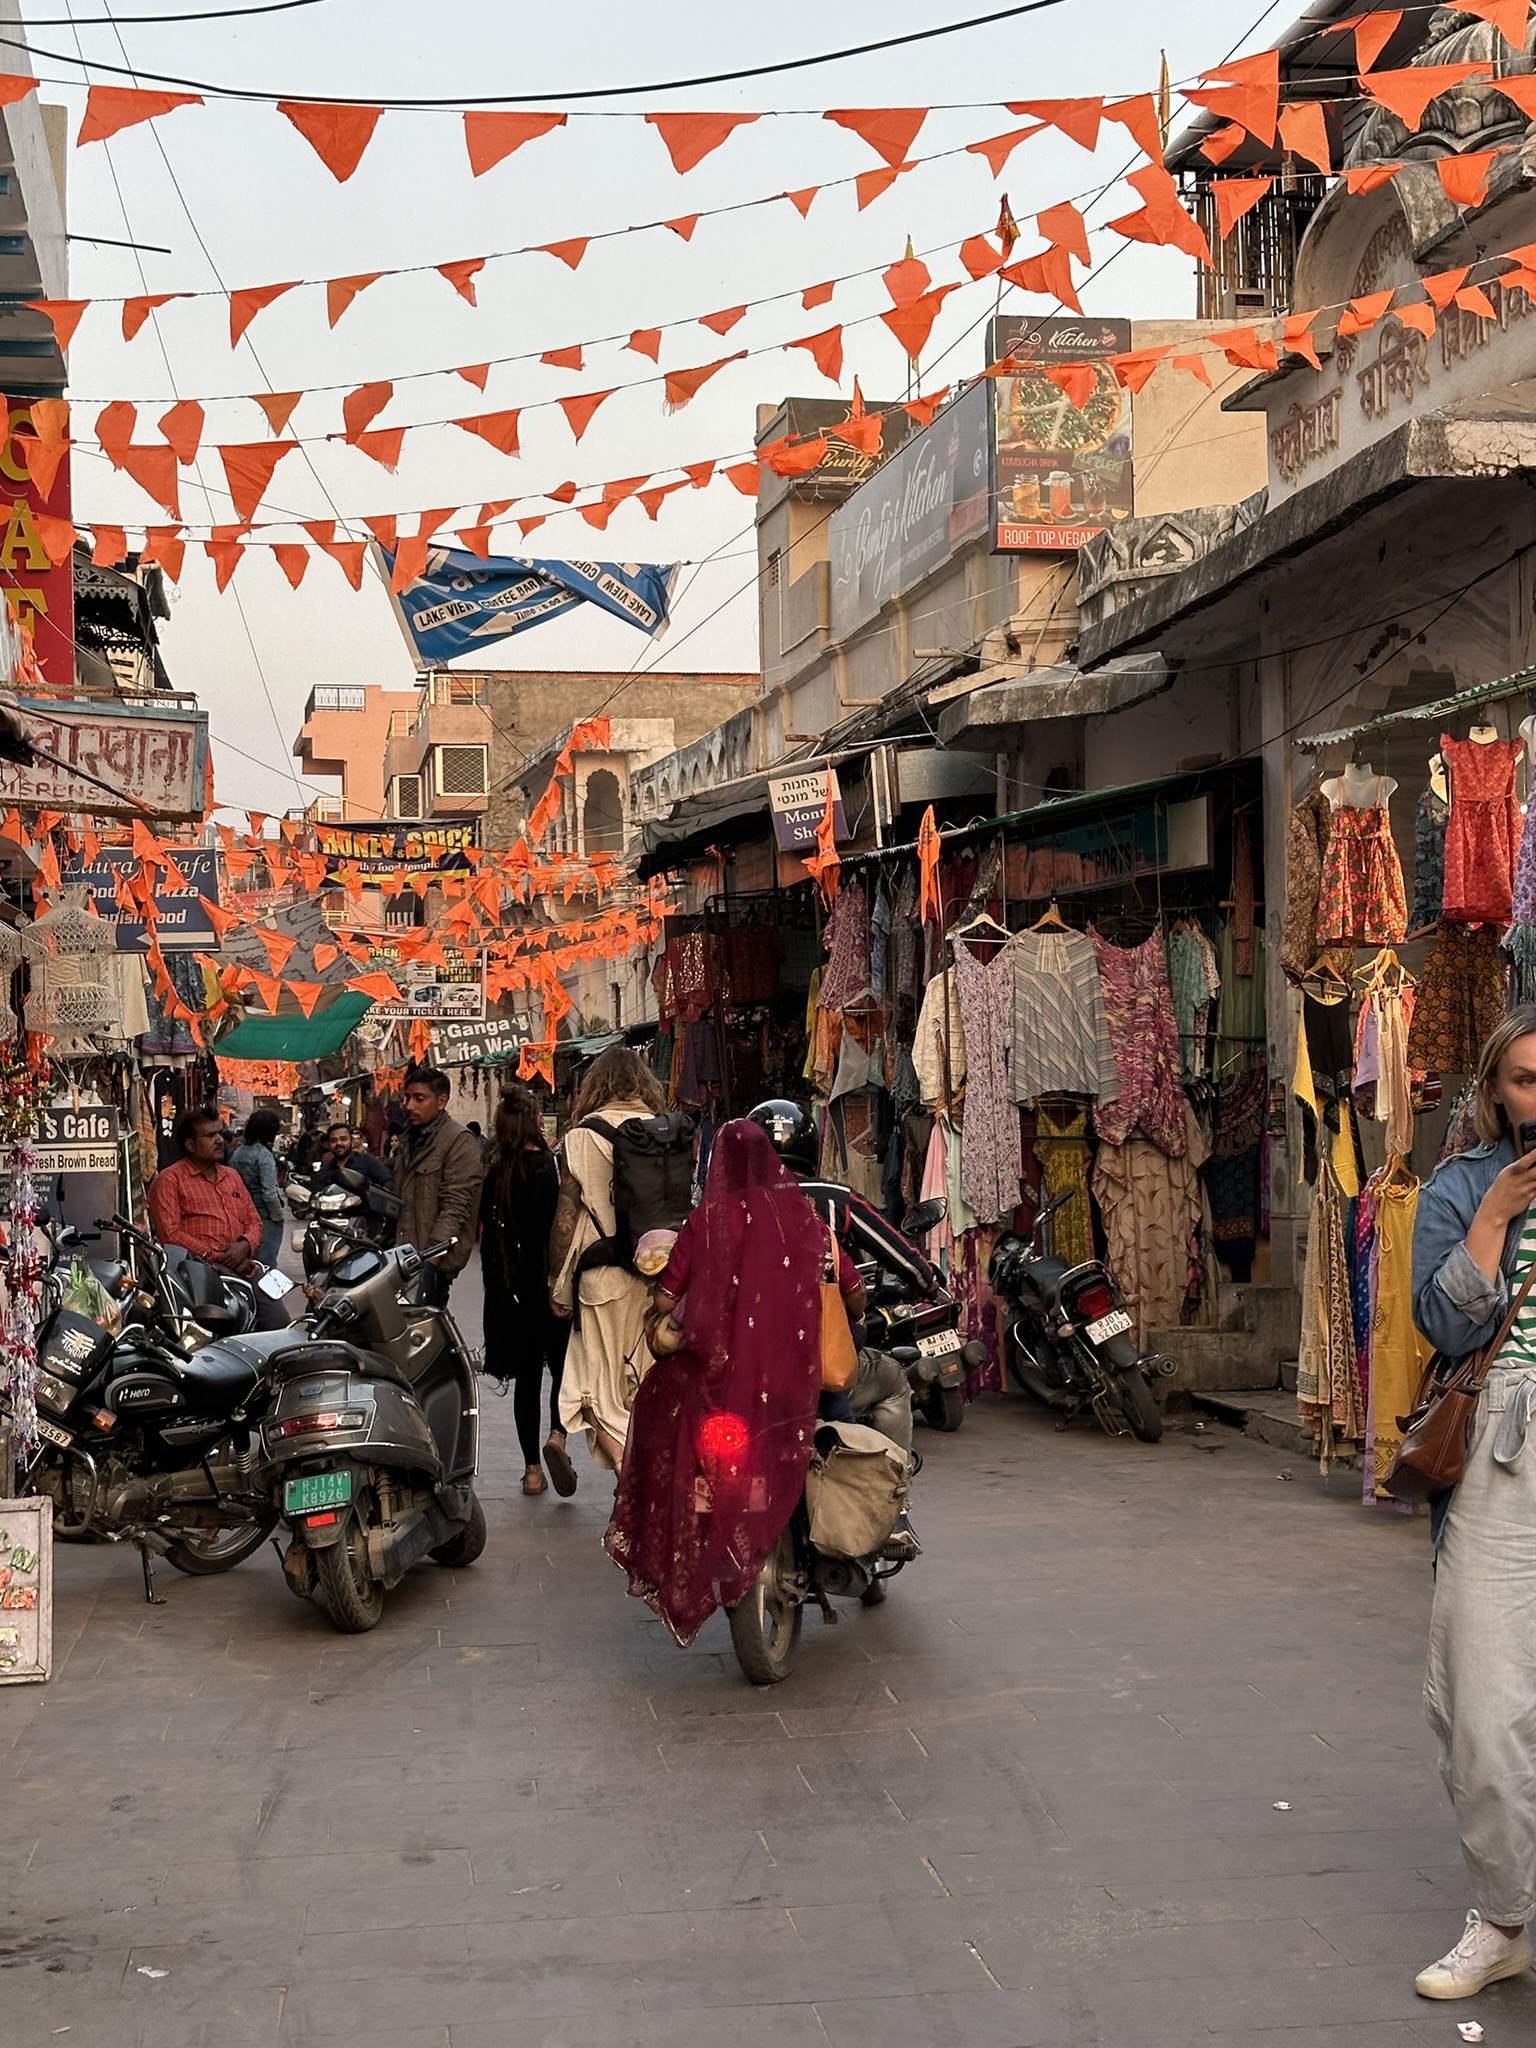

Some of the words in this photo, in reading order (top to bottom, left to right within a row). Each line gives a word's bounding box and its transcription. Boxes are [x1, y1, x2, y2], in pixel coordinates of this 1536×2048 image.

[1048, 327, 1099, 348] Kitchen
[817, 451, 874, 479] Bunty
[1001, 457, 1039, 468] KOMBUCHA
[900, 439, 949, 541] Kitchen
[1004, 529, 1032, 545] ROOF
[1034, 530, 1056, 545] TOP
[1058, 531, 1095, 546] VEGAN
[602, 579, 628, 603] VIEW
[418, 609, 447, 627] LAKE
[446, 600, 475, 618] VIEW
[481, 590, 518, 608] COFFEE
[517, 578, 538, 596] BAR
[627, 600, 652, 622] LAKE
[514, 607, 536, 621] Time
[781, 777, 818, 792] החנות
[812, 786, 829, 798] של
[777, 792, 809, 805] מונטי
[784, 808, 834, 825] Mont
[406, 826, 473, 858] SPICE
[377, 861, 400, 872] food
[404, 861, 440, 872] temple
[157, 909, 187, 924] ood
[384, 1007, 410, 1015] YOUR
[412, 1007, 443, 1016] TICKET
[447, 1008, 472, 1016] HERE
[446, 1018, 510, 1039] Ganga
[433, 1041, 481, 1064] Lffa
[484, 1034, 530, 1055] Wala
[63, 1113, 110, 1139] Cafe
[34, 1152, 55, 1169] resh
[57, 1154, 86, 1169] Brown
[89, 1153, 115, 1168] Bread
[1097, 1312, 1120, 1329] RJ01
[302, 1474, 343, 1492] RJ14V
[302, 1488, 343, 1507] K8926
